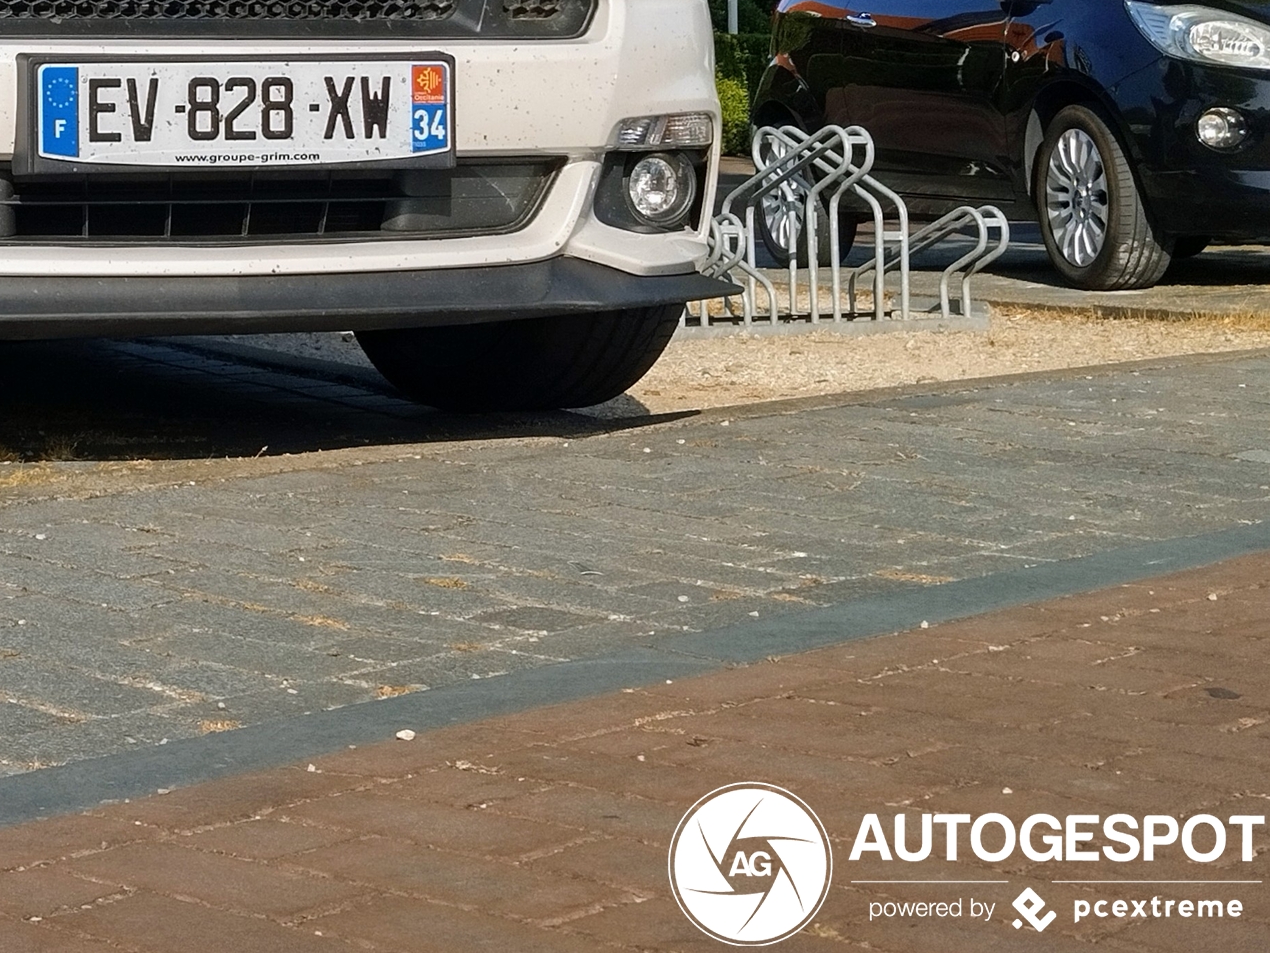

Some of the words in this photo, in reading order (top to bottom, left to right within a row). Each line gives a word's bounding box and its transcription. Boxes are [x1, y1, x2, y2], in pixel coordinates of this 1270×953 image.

[54, 119, 67, 138] F
[413, 109, 446, 141] 34
[175, 151, 321, 164] www.groupe-grim.com
